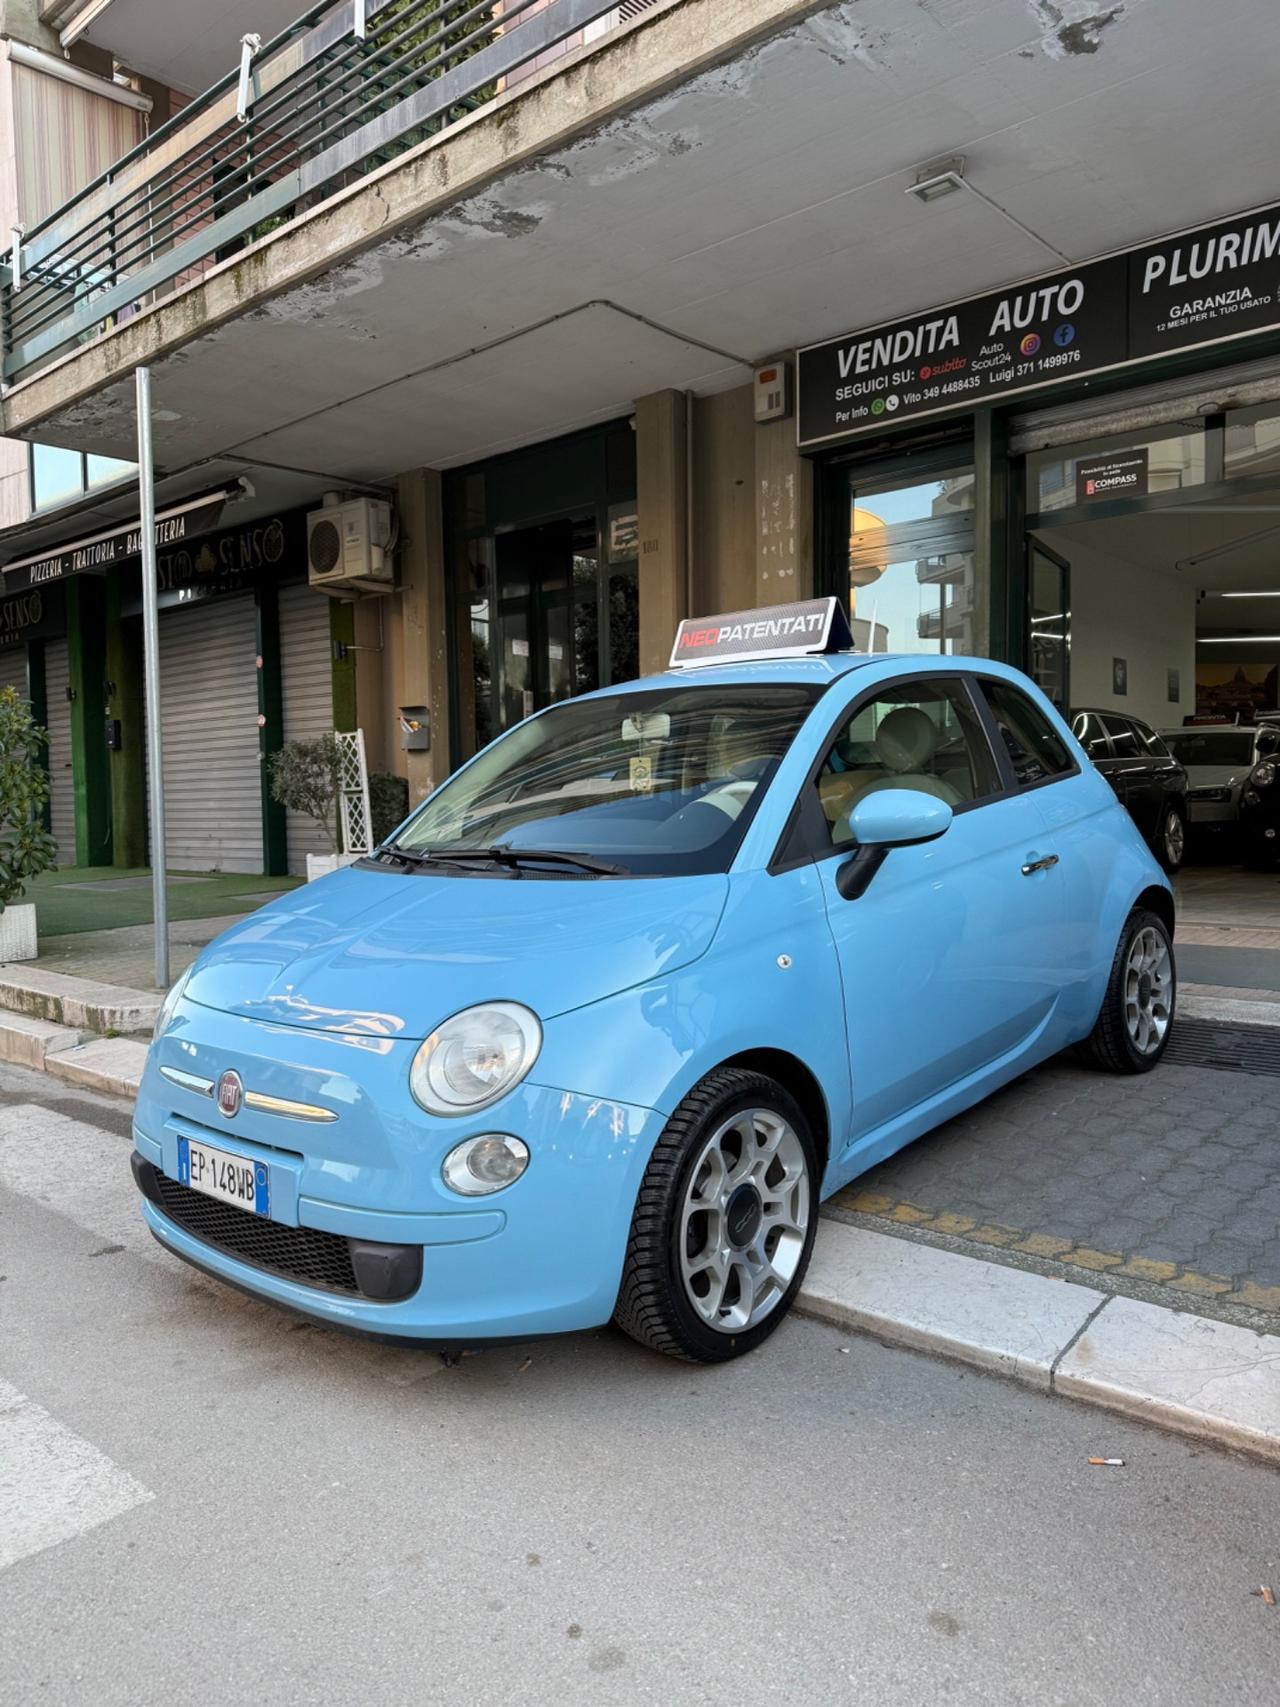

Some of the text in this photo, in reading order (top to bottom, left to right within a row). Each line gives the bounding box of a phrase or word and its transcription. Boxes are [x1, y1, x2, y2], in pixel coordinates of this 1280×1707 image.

[1156, 296, 1271, 332] 12 MESI PER IL TUO USATO
[1169, 286, 1253, 319] GARANZIA
[837, 279, 1085, 378] VENDITA AUTO
[970, 352, 1012, 371] Scout24
[979, 342, 1005, 357] Auto
[932, 357, 968, 376] subito
[835, 369, 915, 401] SEGUICI SU:
[835, 350, 1081, 423] Per Info Vito 349 4488435 Luigi 371 1499976
[1094, 473, 1137, 488] COMPASS
[30, 557, 63, 584] PIZZERIA
[72, 541, 116, 571] TRATTORIA
[126, 517, 185, 554] BAGTTERIA
[222, 1084, 238, 1105] FIAT
